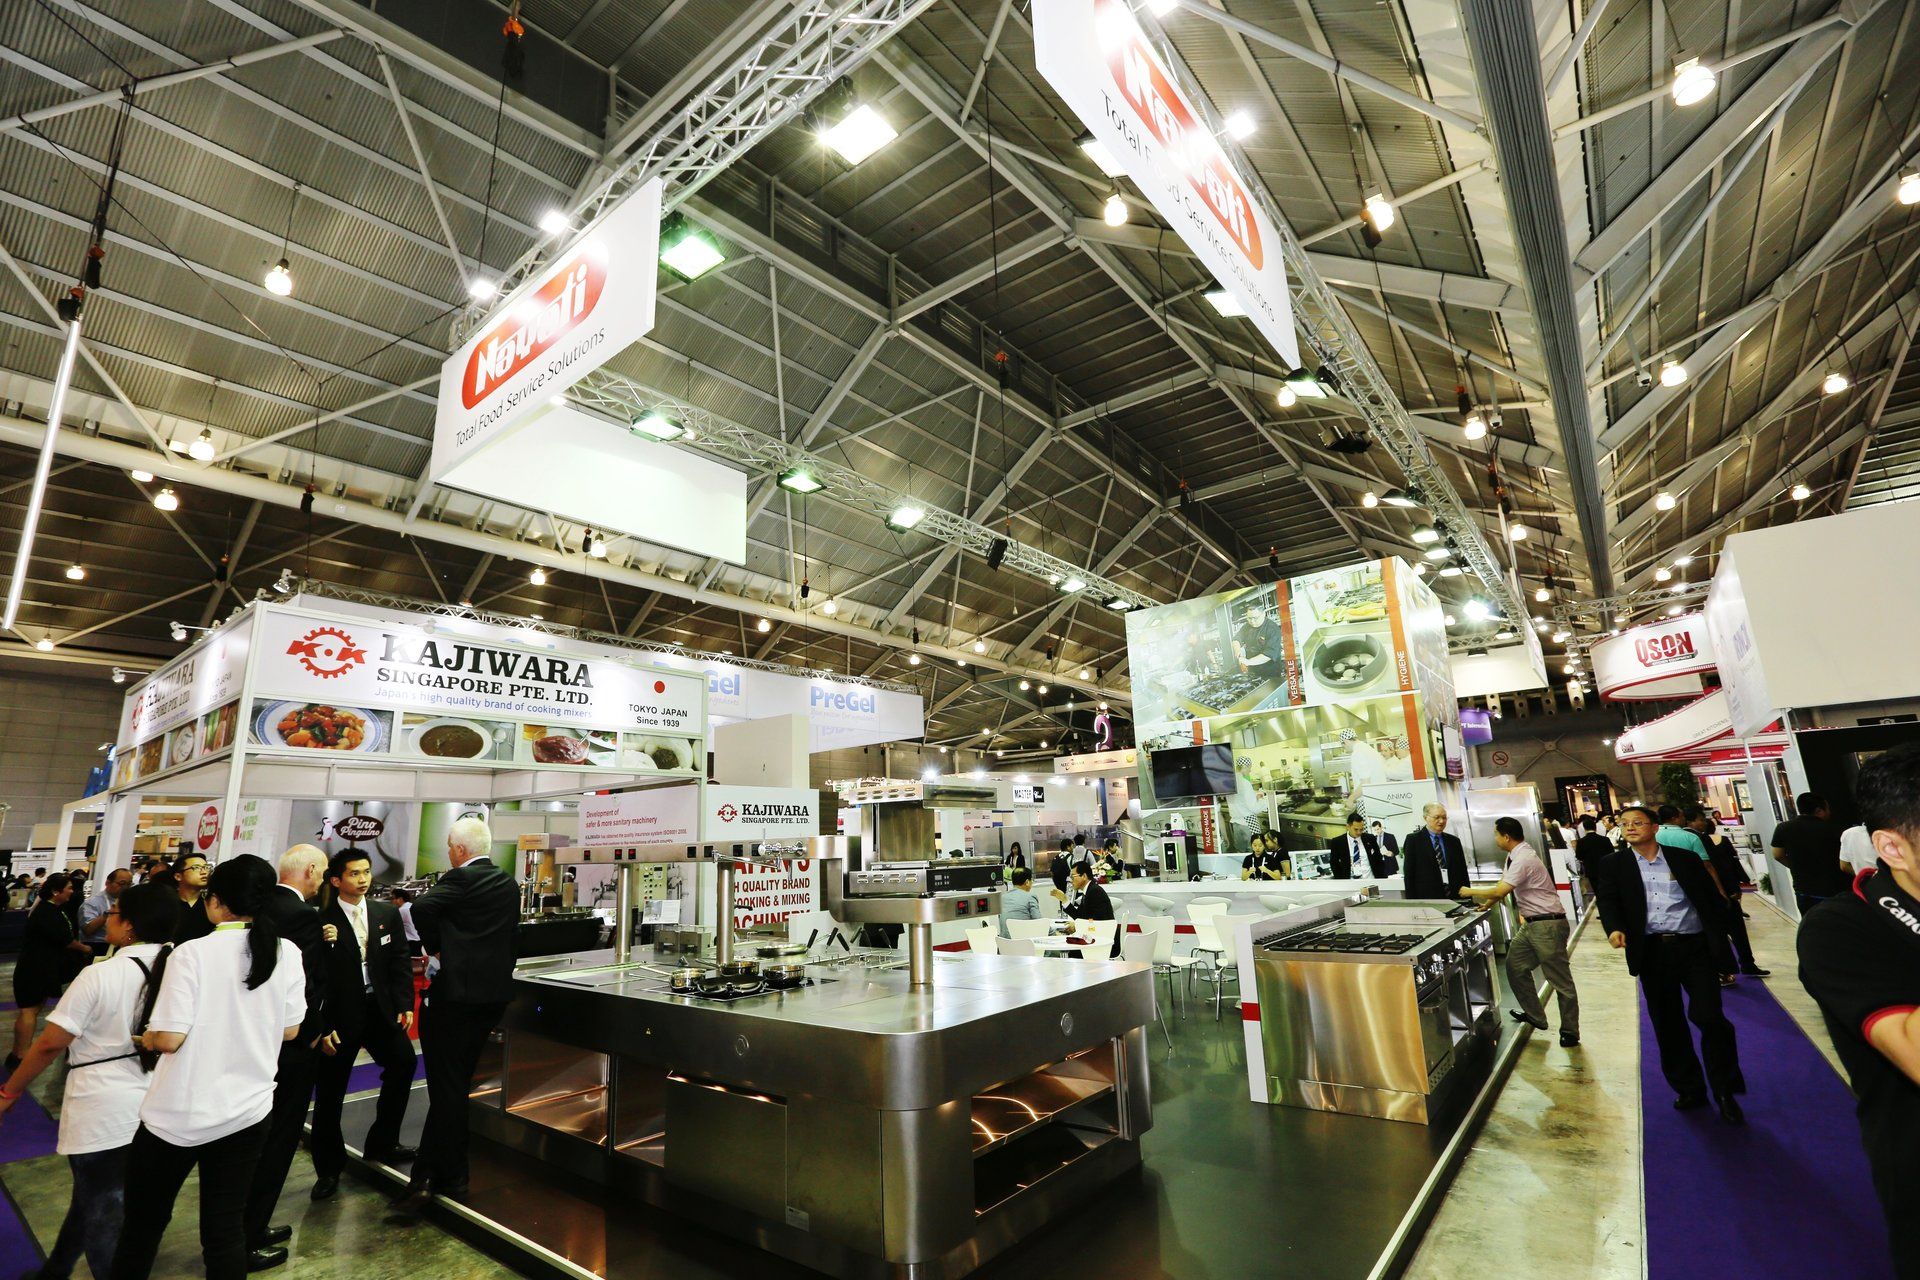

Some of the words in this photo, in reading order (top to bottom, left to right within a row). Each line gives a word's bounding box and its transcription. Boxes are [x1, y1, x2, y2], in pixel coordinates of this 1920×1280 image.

[1101, 89, 1141, 157] Total
[1184, 196, 1228, 263] Service
[456, 418, 477, 447] Total
[478, 401, 503, 432] Food
[506, 374, 545, 412] Service
[547, 327, 605, 381] Solutions
[379, 633, 594, 689] KAJIWARA
[1635, 631, 1695, 667] QSON
[1287, 659, 1299, 701] VERSATILE
[1397, 650, 1410, 686] HYGIENE
[377, 667, 503, 695] SINGAPORE
[508, 683, 549, 700] PTE.
[555, 689, 593, 705] LTD.
[704, 669, 740, 696] Gel
[811, 685, 875, 714] PreGel
[420, 691, 443, 704] high
[446, 695, 482, 709] quality
[484, 698, 512, 711] brand
[514, 702, 525, 711] of
[527, 703, 562, 717] cooking
[563, 707, 593, 718] mixers
[629, 703, 658, 715] TOKYO
[661, 707, 688, 718] JAPAN
[636, 716, 659, 726] Since
[662, 718, 680, 728] 1939
[347, 817, 377, 830] Pino
[586, 810, 614, 819] Development
[586, 820, 597, 829] safer
[613, 818, 631, 826] sanitary
[632, 816, 658, 825] machinery
[741, 804, 810, 817] KAJIWARA
[340, 826, 381, 839] Pinguino
[1203, 809, 1211, 847] TAILOR-MADE
[742, 879, 780, 893] QUALITY
[782, 877, 810, 890] BRAND
[773, 895, 780, 907] &
[782, 893, 811, 905] MIXING
[1878, 896, 1920, 935] Cano
